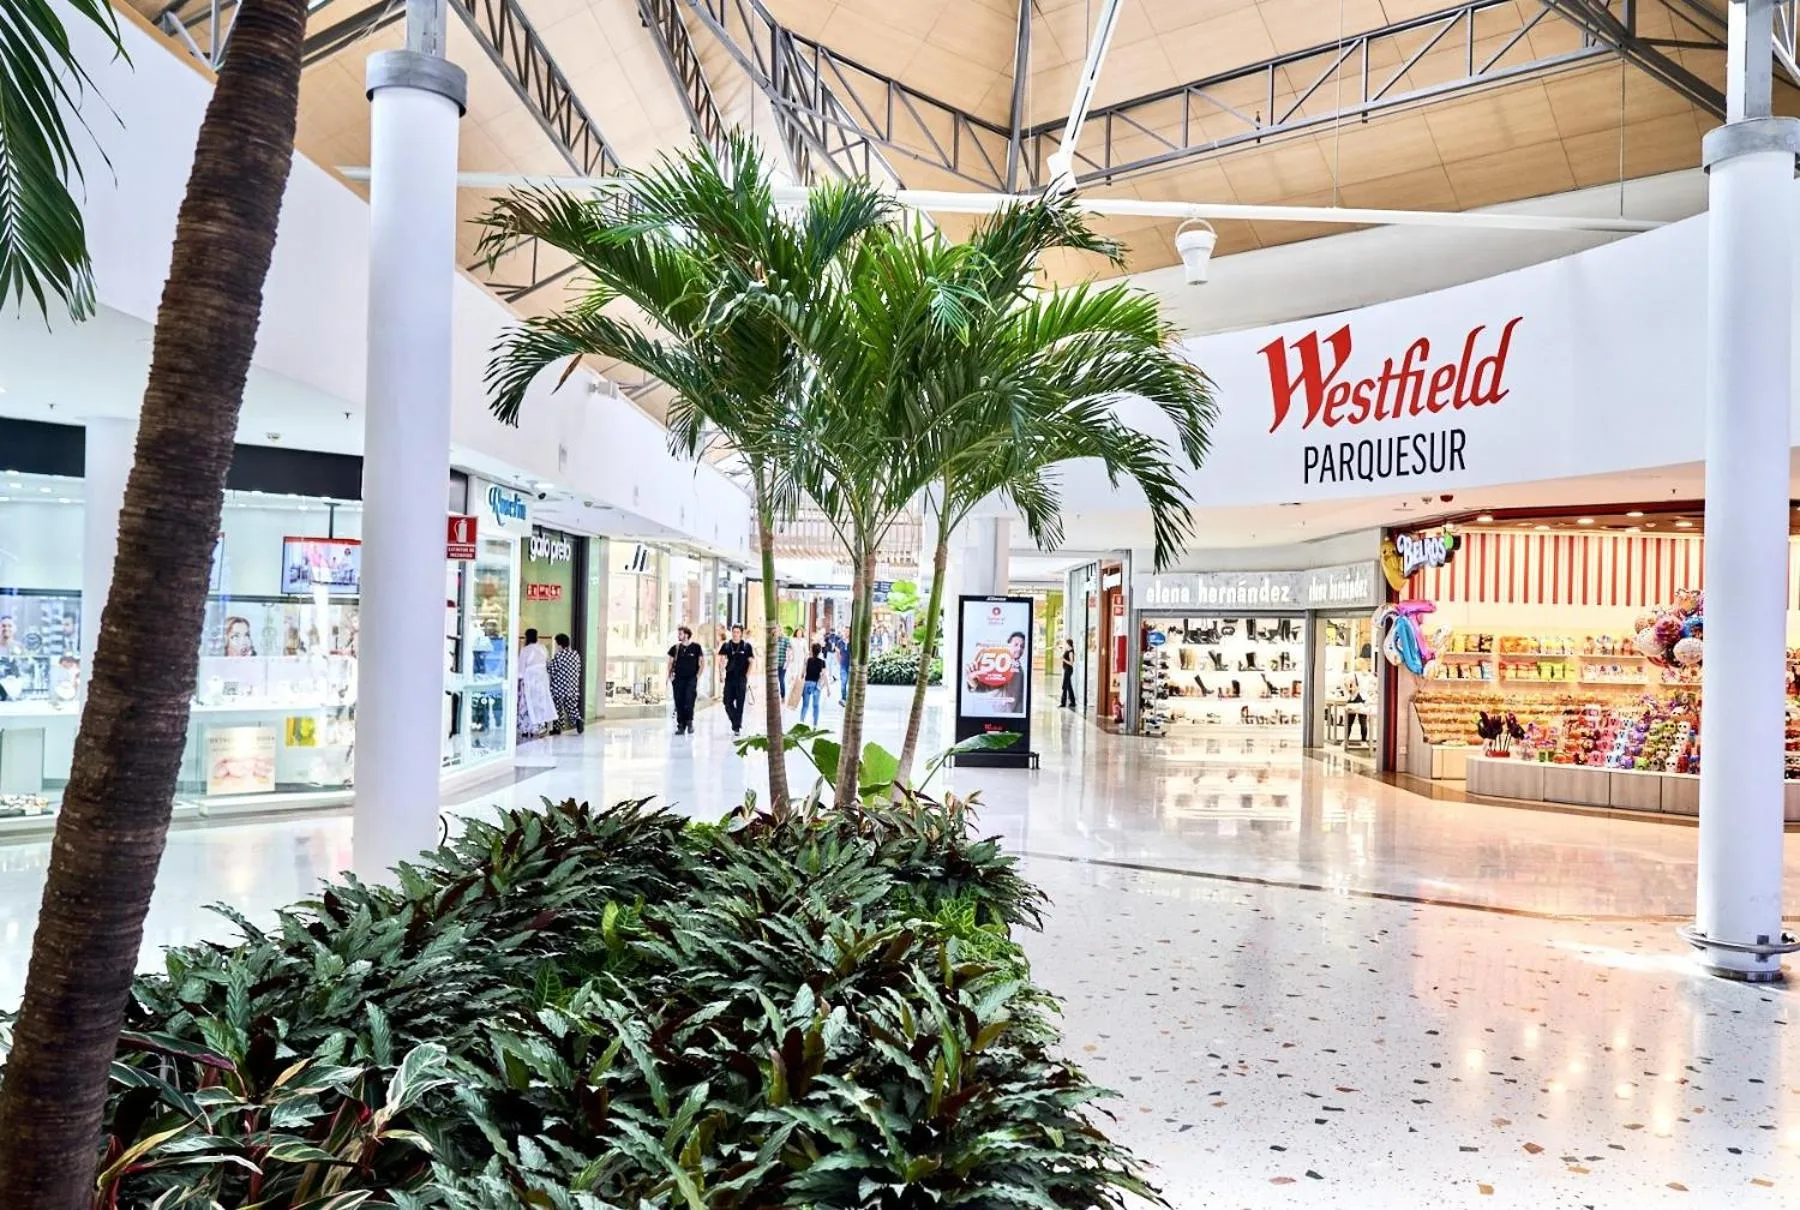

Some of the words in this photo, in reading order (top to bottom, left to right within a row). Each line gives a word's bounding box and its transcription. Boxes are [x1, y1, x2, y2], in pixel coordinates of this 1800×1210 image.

[1257, 317, 1523, 433] Westfield
[1304, 428, 1466, 484] PARQUESUR
[1146, 580, 1190, 603] elena
[1199, 578, 1291, 603] hernández
